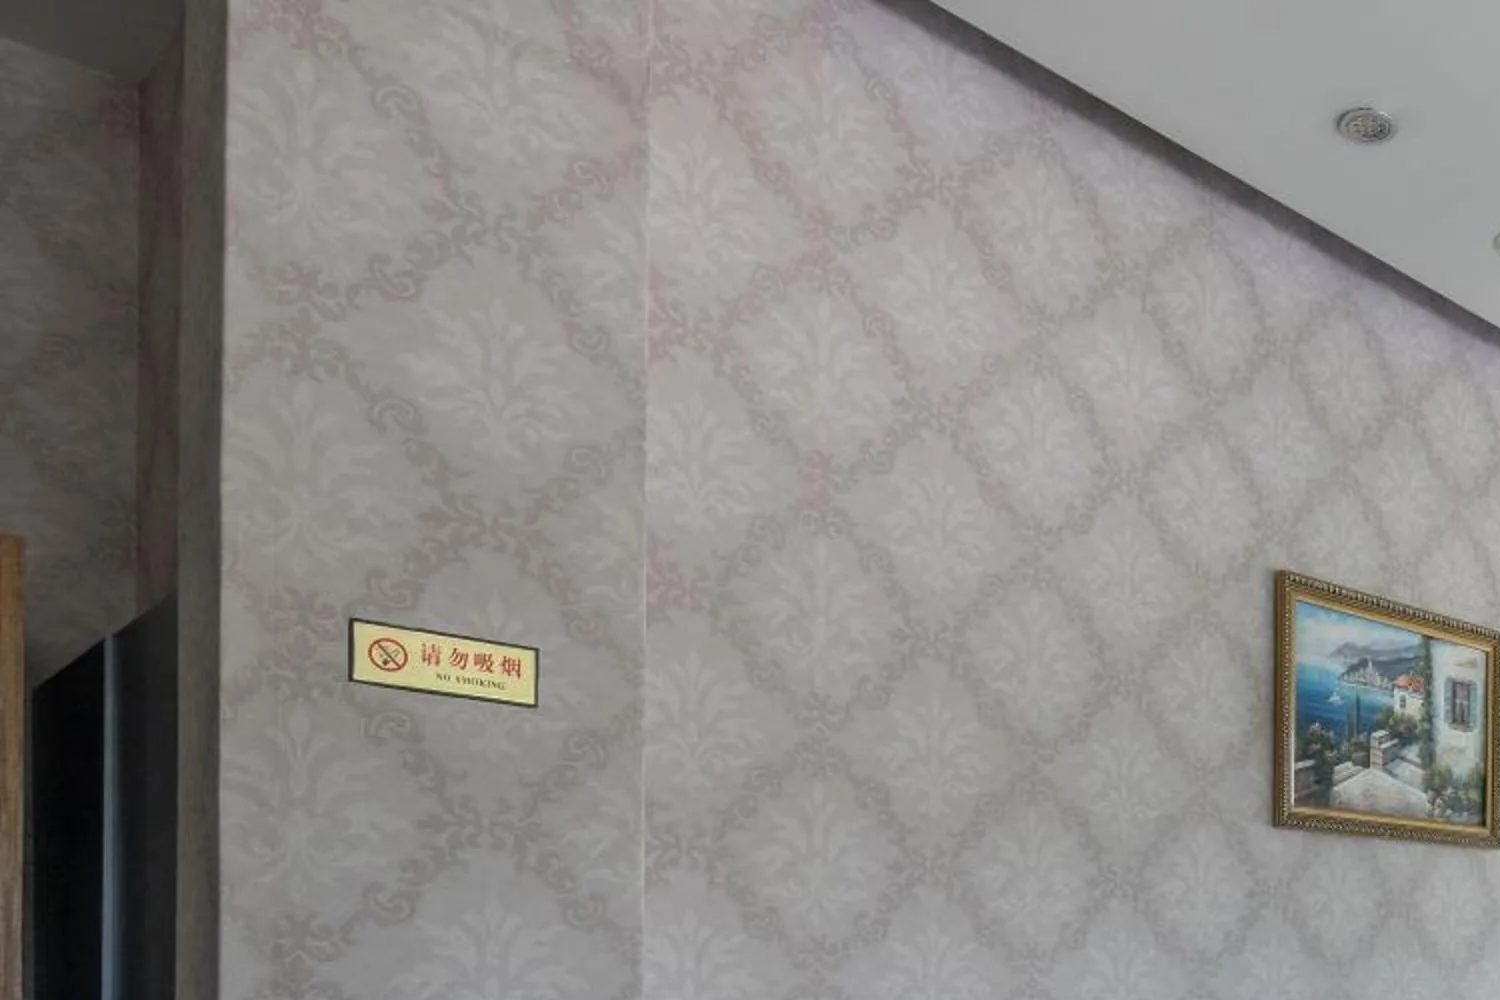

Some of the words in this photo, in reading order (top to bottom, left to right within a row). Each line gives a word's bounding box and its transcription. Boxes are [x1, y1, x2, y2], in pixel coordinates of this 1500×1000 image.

[421, 643, 521, 679] 请勿吸烟
[436, 672, 451, 681] NO
[456, 675, 506, 689] SMOKING
